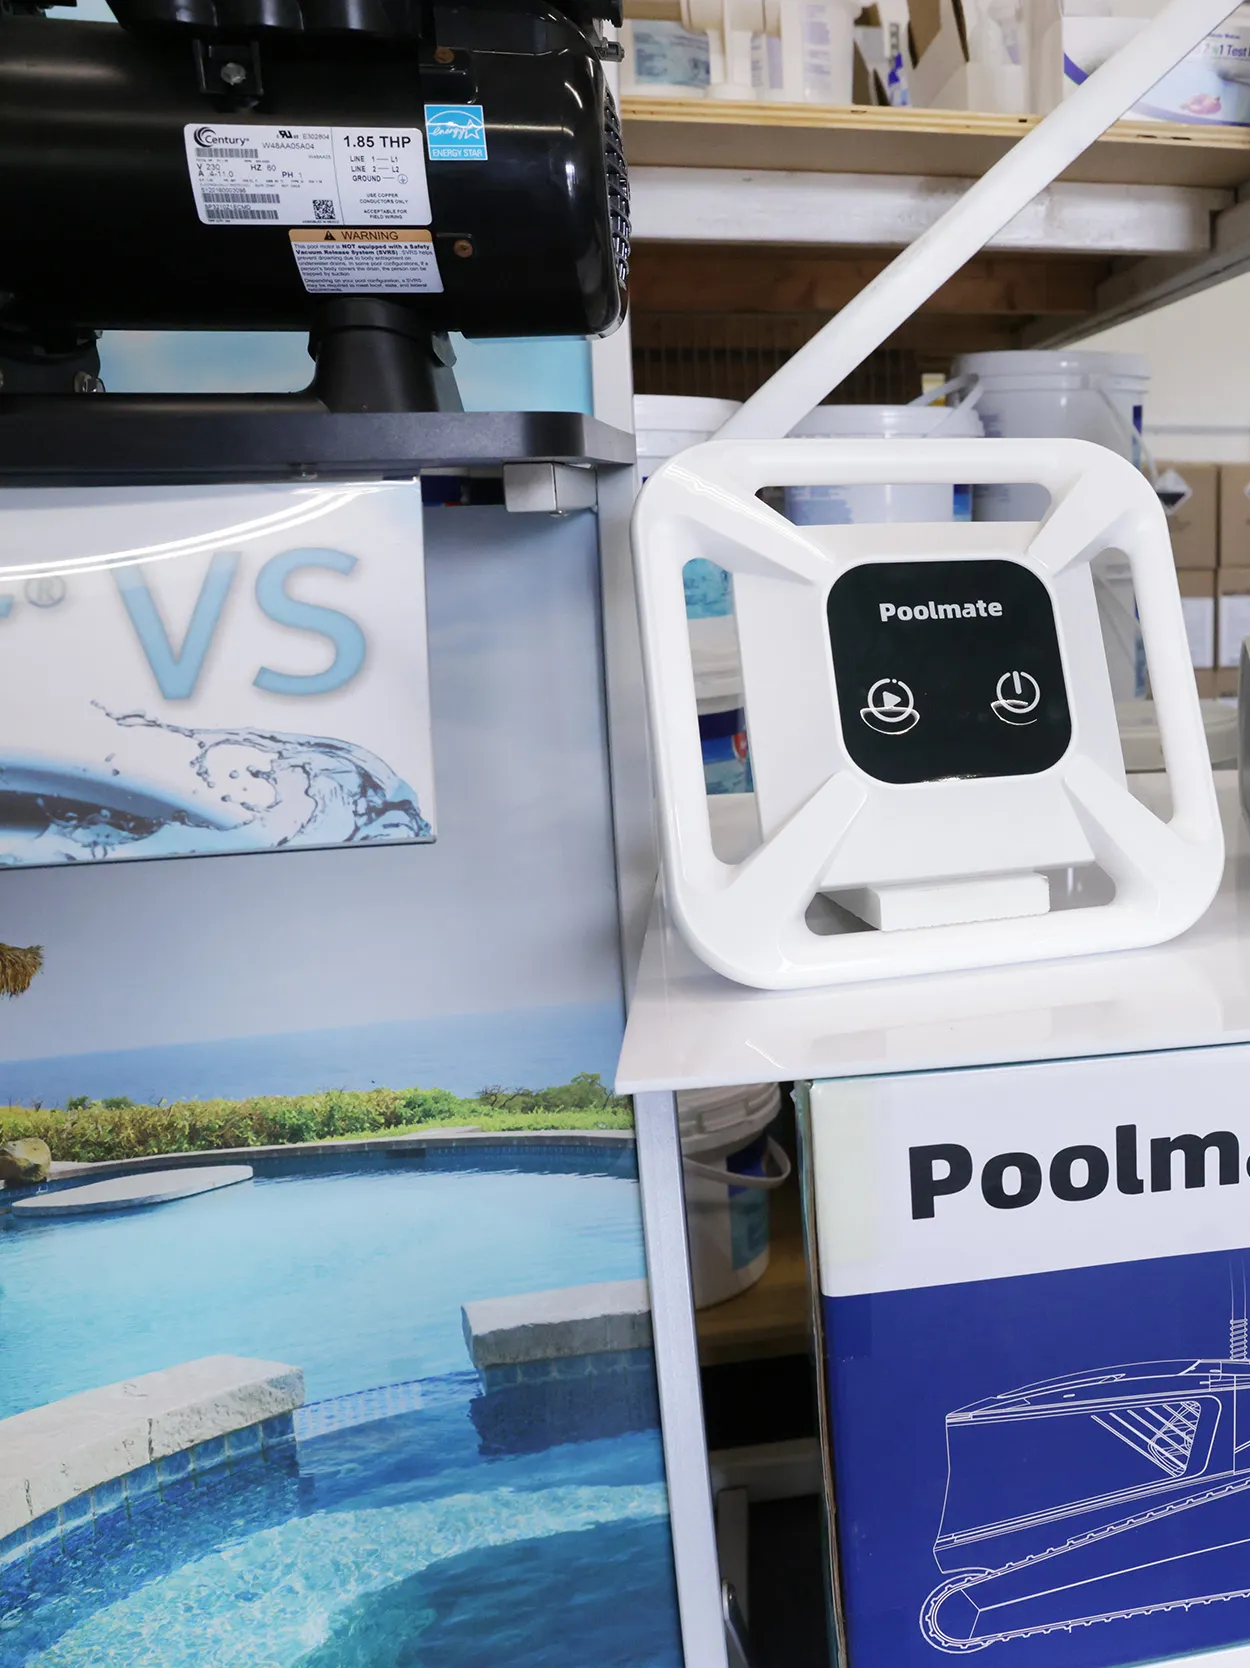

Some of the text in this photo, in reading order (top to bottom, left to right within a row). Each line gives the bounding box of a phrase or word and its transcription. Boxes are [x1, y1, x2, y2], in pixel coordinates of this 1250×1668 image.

[1227, 44, 1247, 57] Test
[205, 135, 246, 147] Century
[343, 135, 412, 148] 1.85 THP
[432, 148, 483, 158] ENERGY STAR
[349, 155, 365, 163] LINE
[196, 163, 203, 171] V
[206, 163, 220, 171] 230
[250, 164, 262, 172] HZ
[350, 165, 366, 173] LINE
[341, 231, 399, 241] WARNING
[879, 600, 1003, 623] Poolmate
[110, 546, 367, 701] VS
